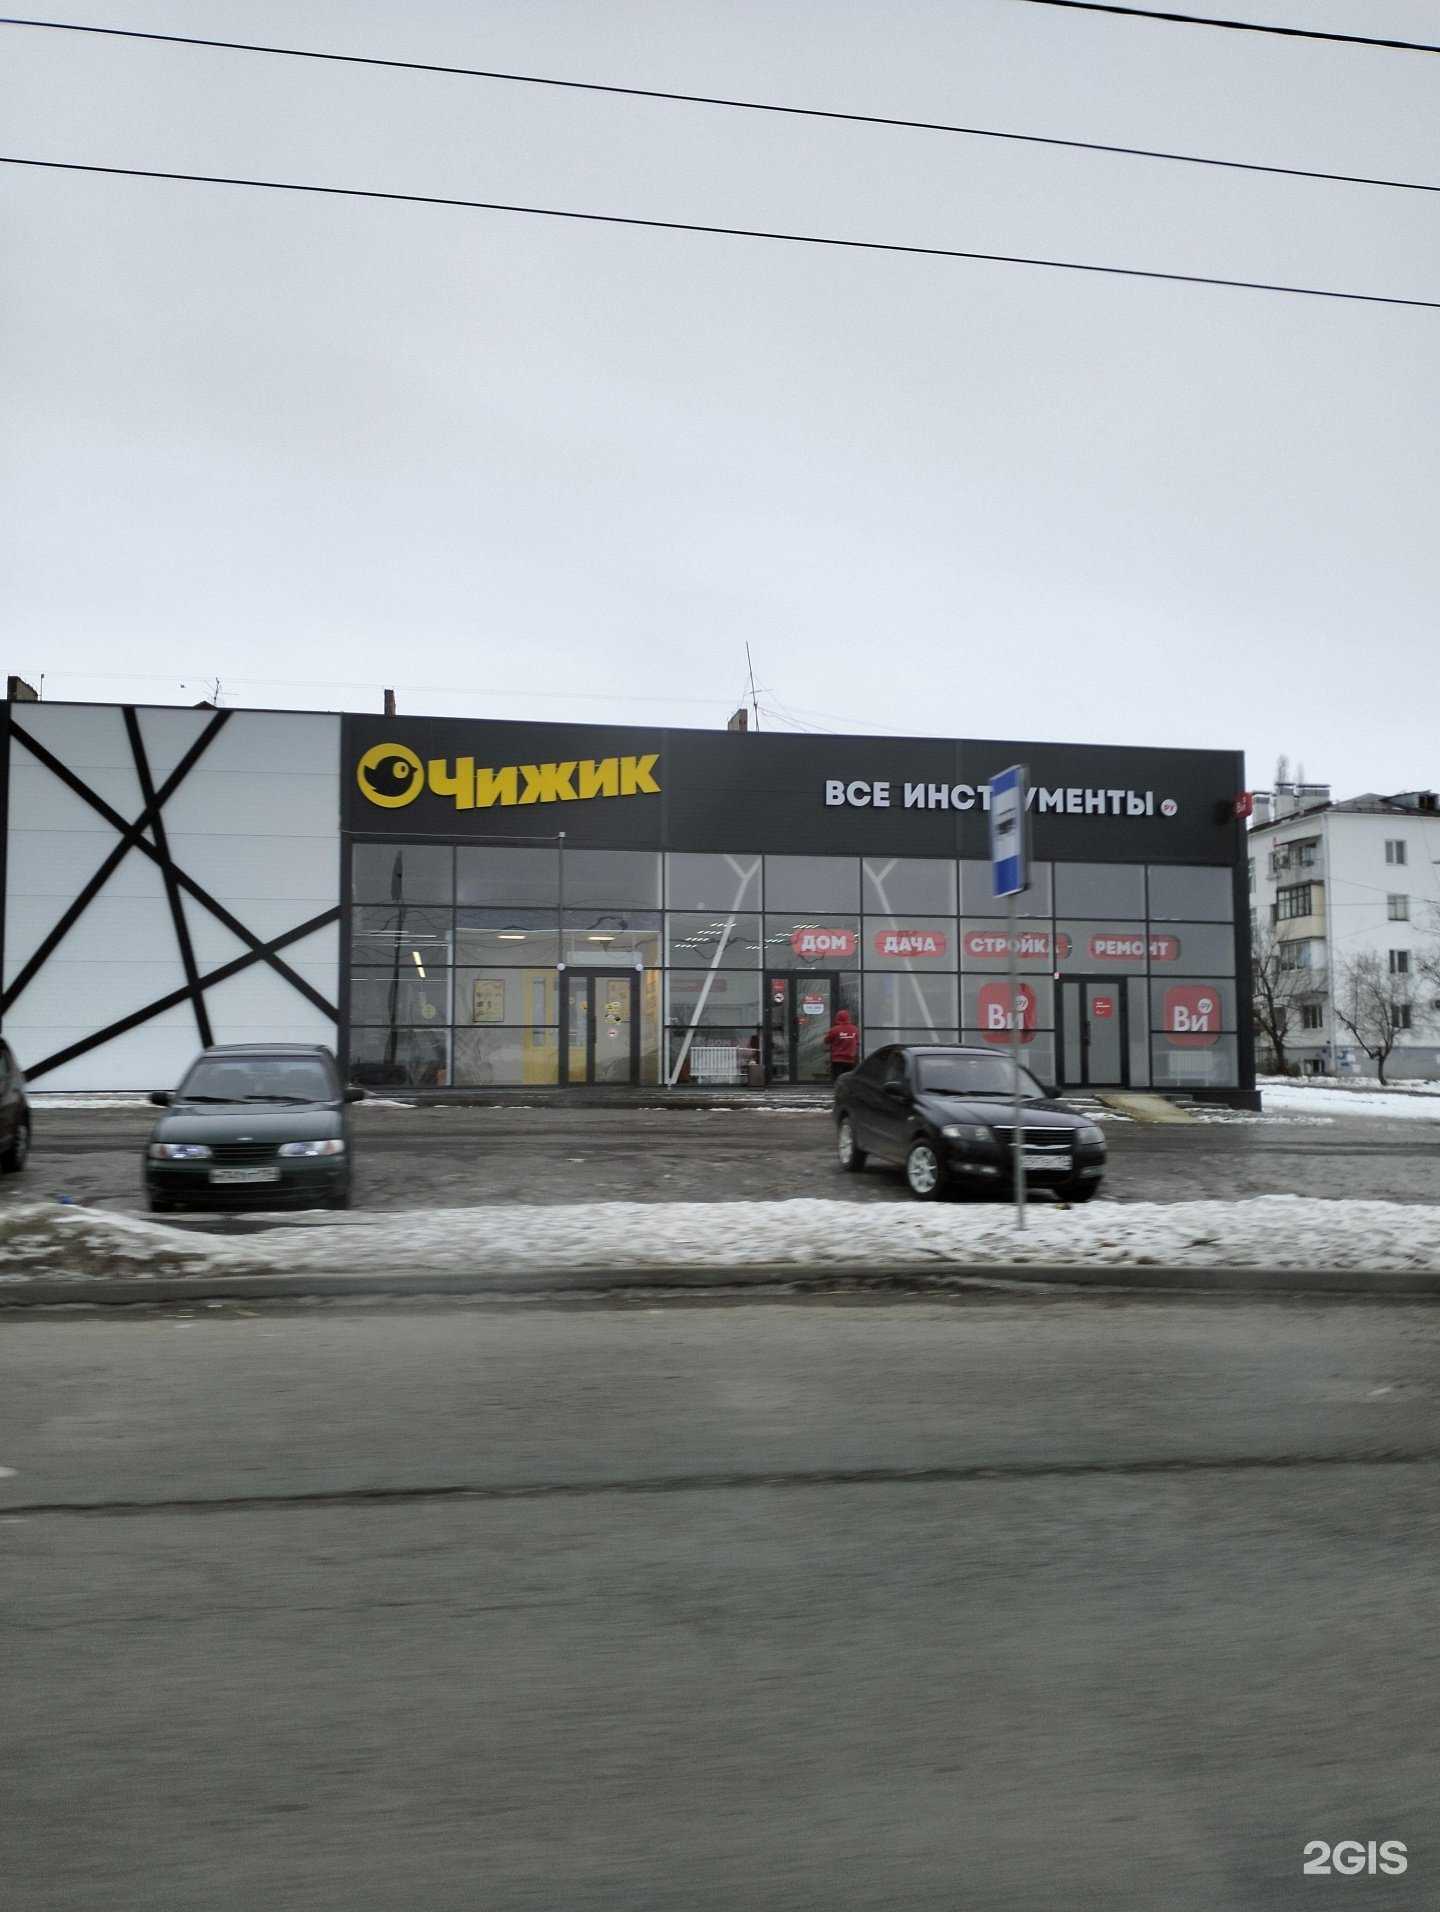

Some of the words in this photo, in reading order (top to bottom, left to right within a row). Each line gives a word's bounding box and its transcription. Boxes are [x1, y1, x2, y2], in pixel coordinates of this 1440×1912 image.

[826, 780, 890, 807] ВСЕ
[904, 783, 1153, 815] ИНСТУМЕНТЫ
[801, 935, 848, 952] ДОМ
[884, 936, 936, 953] ДАЧА
